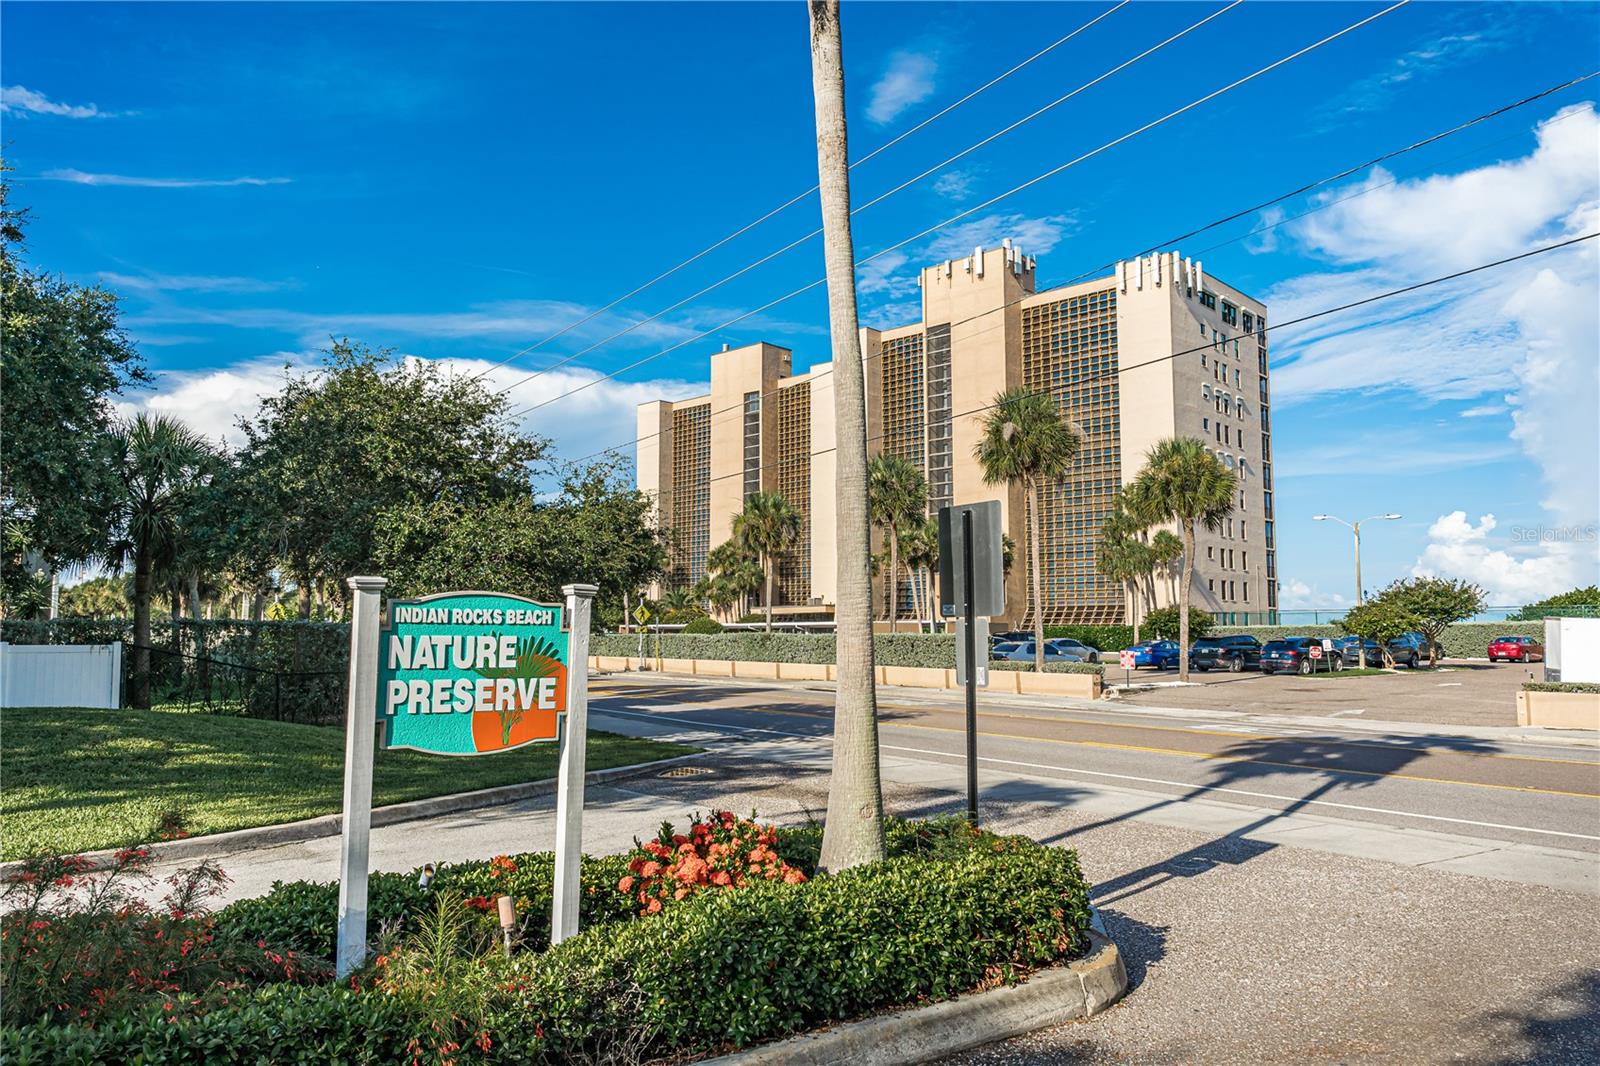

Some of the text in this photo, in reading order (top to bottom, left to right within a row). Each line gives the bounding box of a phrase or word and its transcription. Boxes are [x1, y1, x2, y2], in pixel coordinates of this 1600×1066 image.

[395, 607, 552, 625] INDIAN ROCKS BEACH
[388, 635, 517, 669] NATURE
[385, 677, 556, 715] PRESERVE
